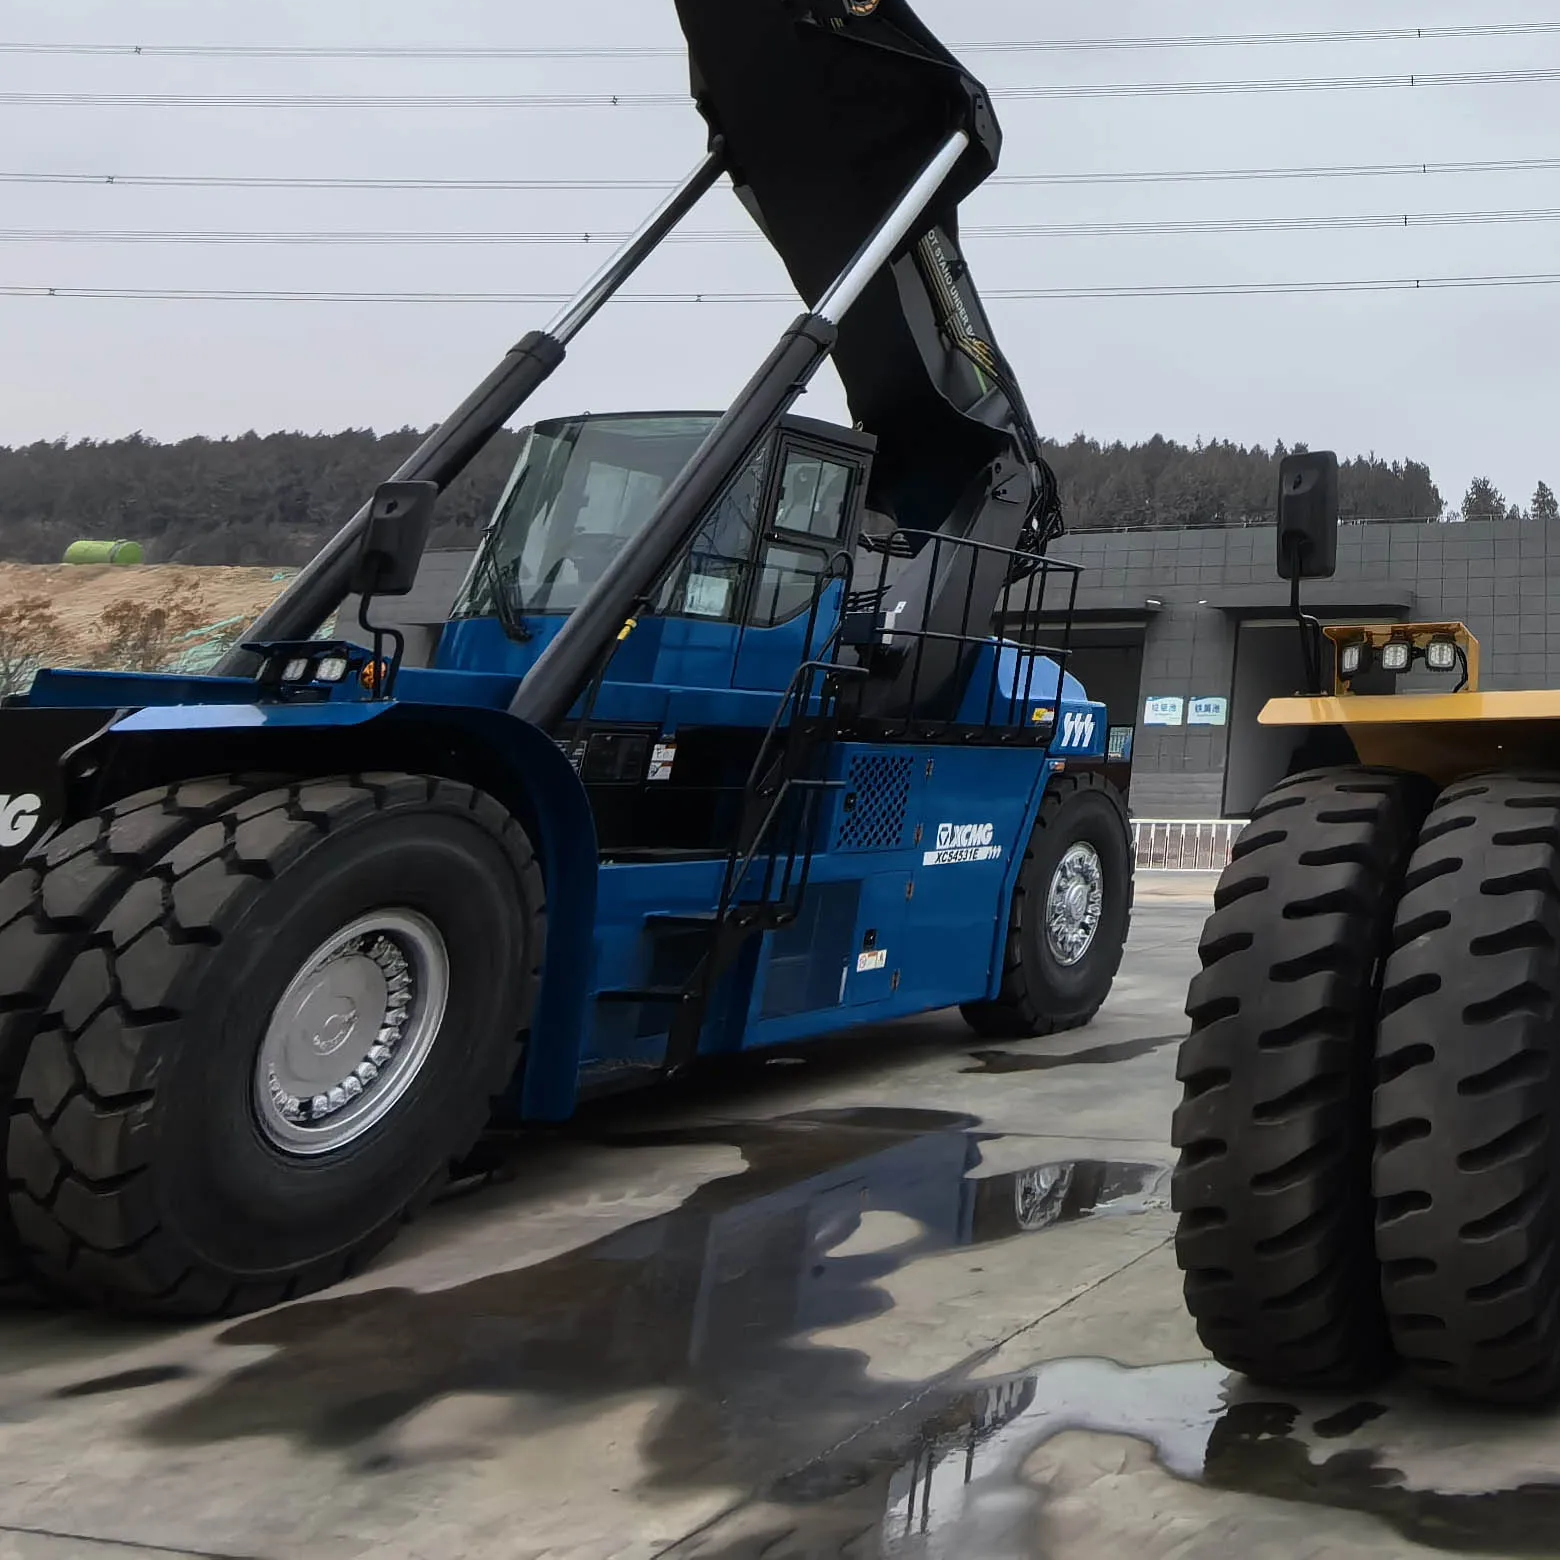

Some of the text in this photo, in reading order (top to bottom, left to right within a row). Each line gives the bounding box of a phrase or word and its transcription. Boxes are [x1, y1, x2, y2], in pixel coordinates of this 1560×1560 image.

[935, 247, 953, 285] STAND
[950, 285, 969, 327] UNDER
[949, 823, 993, 847] XCMG
